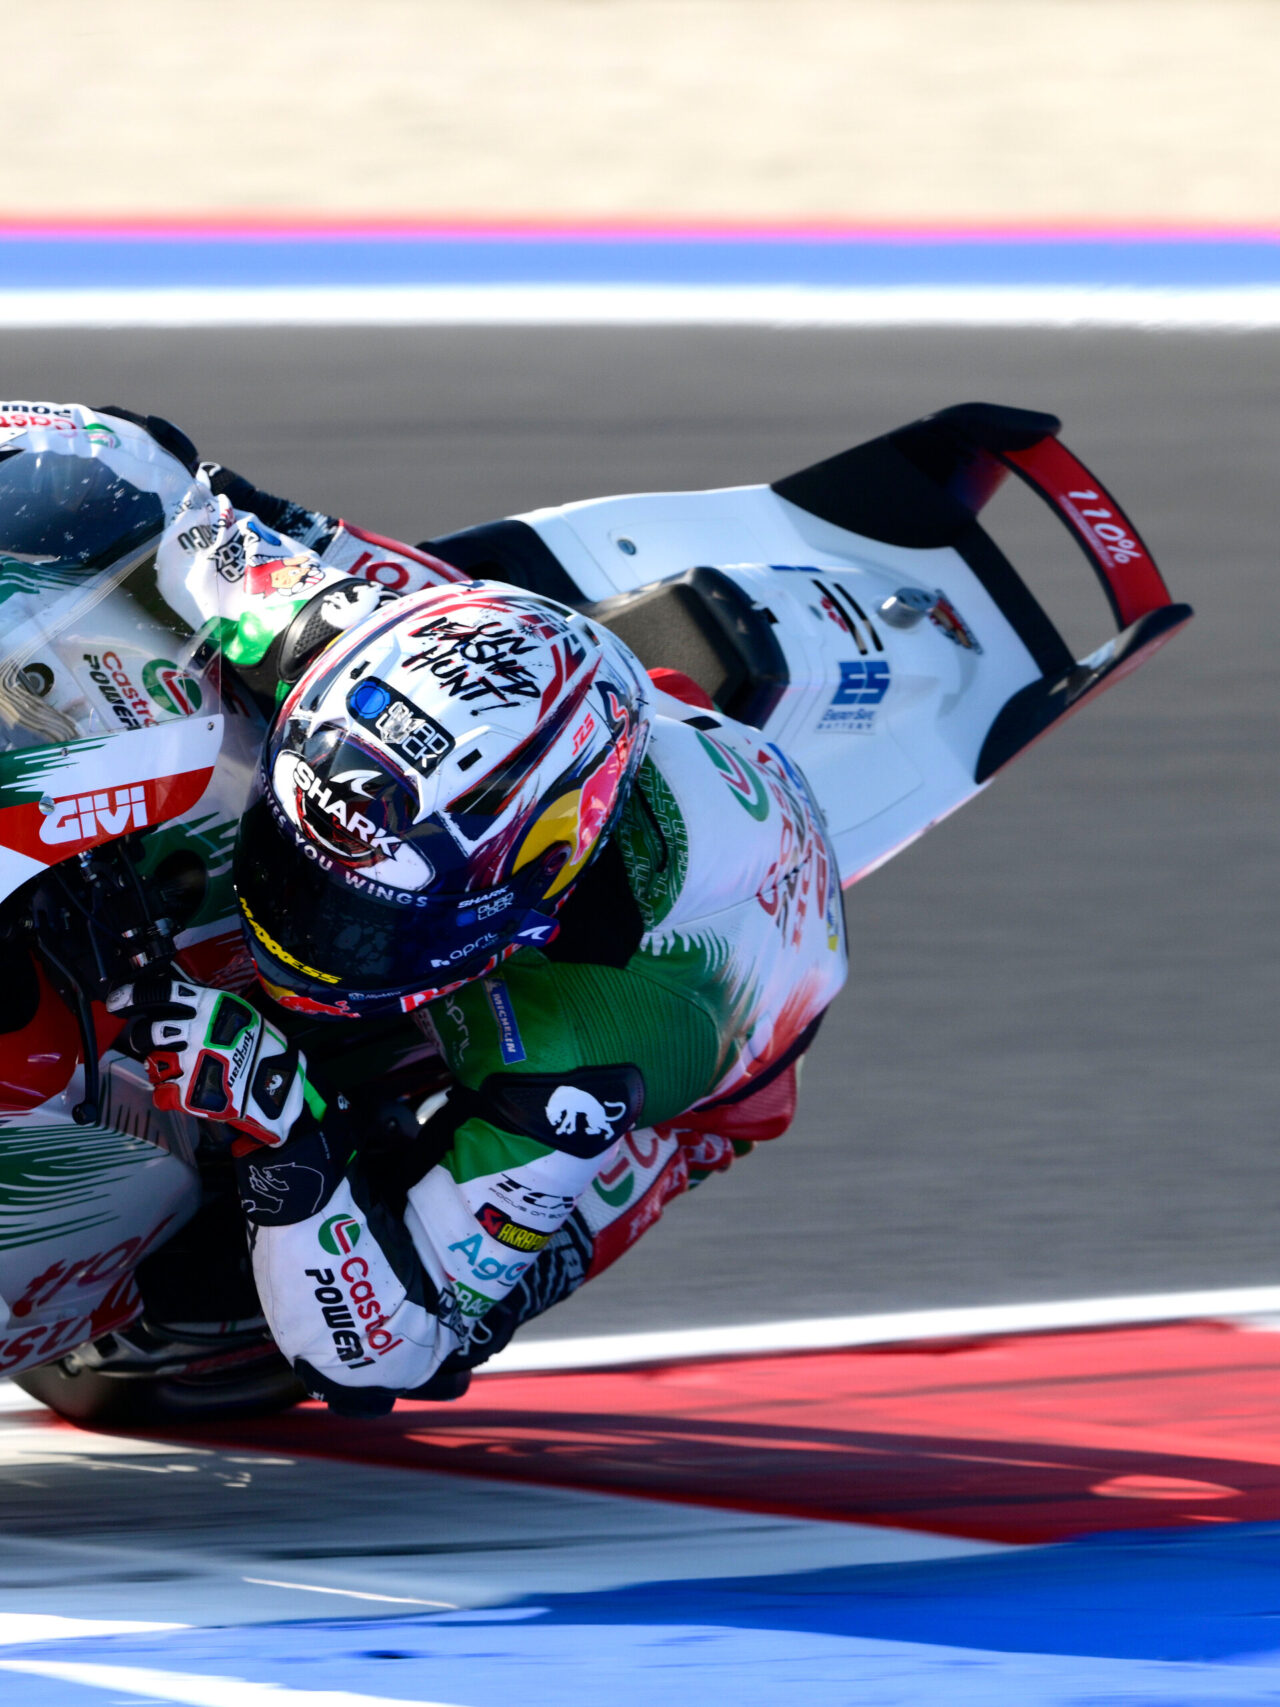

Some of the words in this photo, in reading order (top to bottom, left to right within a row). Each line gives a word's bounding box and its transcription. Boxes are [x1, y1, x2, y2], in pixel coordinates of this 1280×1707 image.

[1068, 489, 1141, 563] 110%
[83, 653, 142, 731] POWER
[102, 651, 160, 728] Castr
[401, 644, 522, 717] HUNT!
[375, 712, 438, 769] LCK
[572, 712, 595, 756] JZ5
[39, 786, 149, 846] GIVI
[293, 760, 403, 862] SHARK
[294, 832, 334, 871] YOU
[345, 871, 430, 909] WINGS
[493, 993, 517, 1054] MICHELIN
[304, 1268, 376, 1370] POWER1
